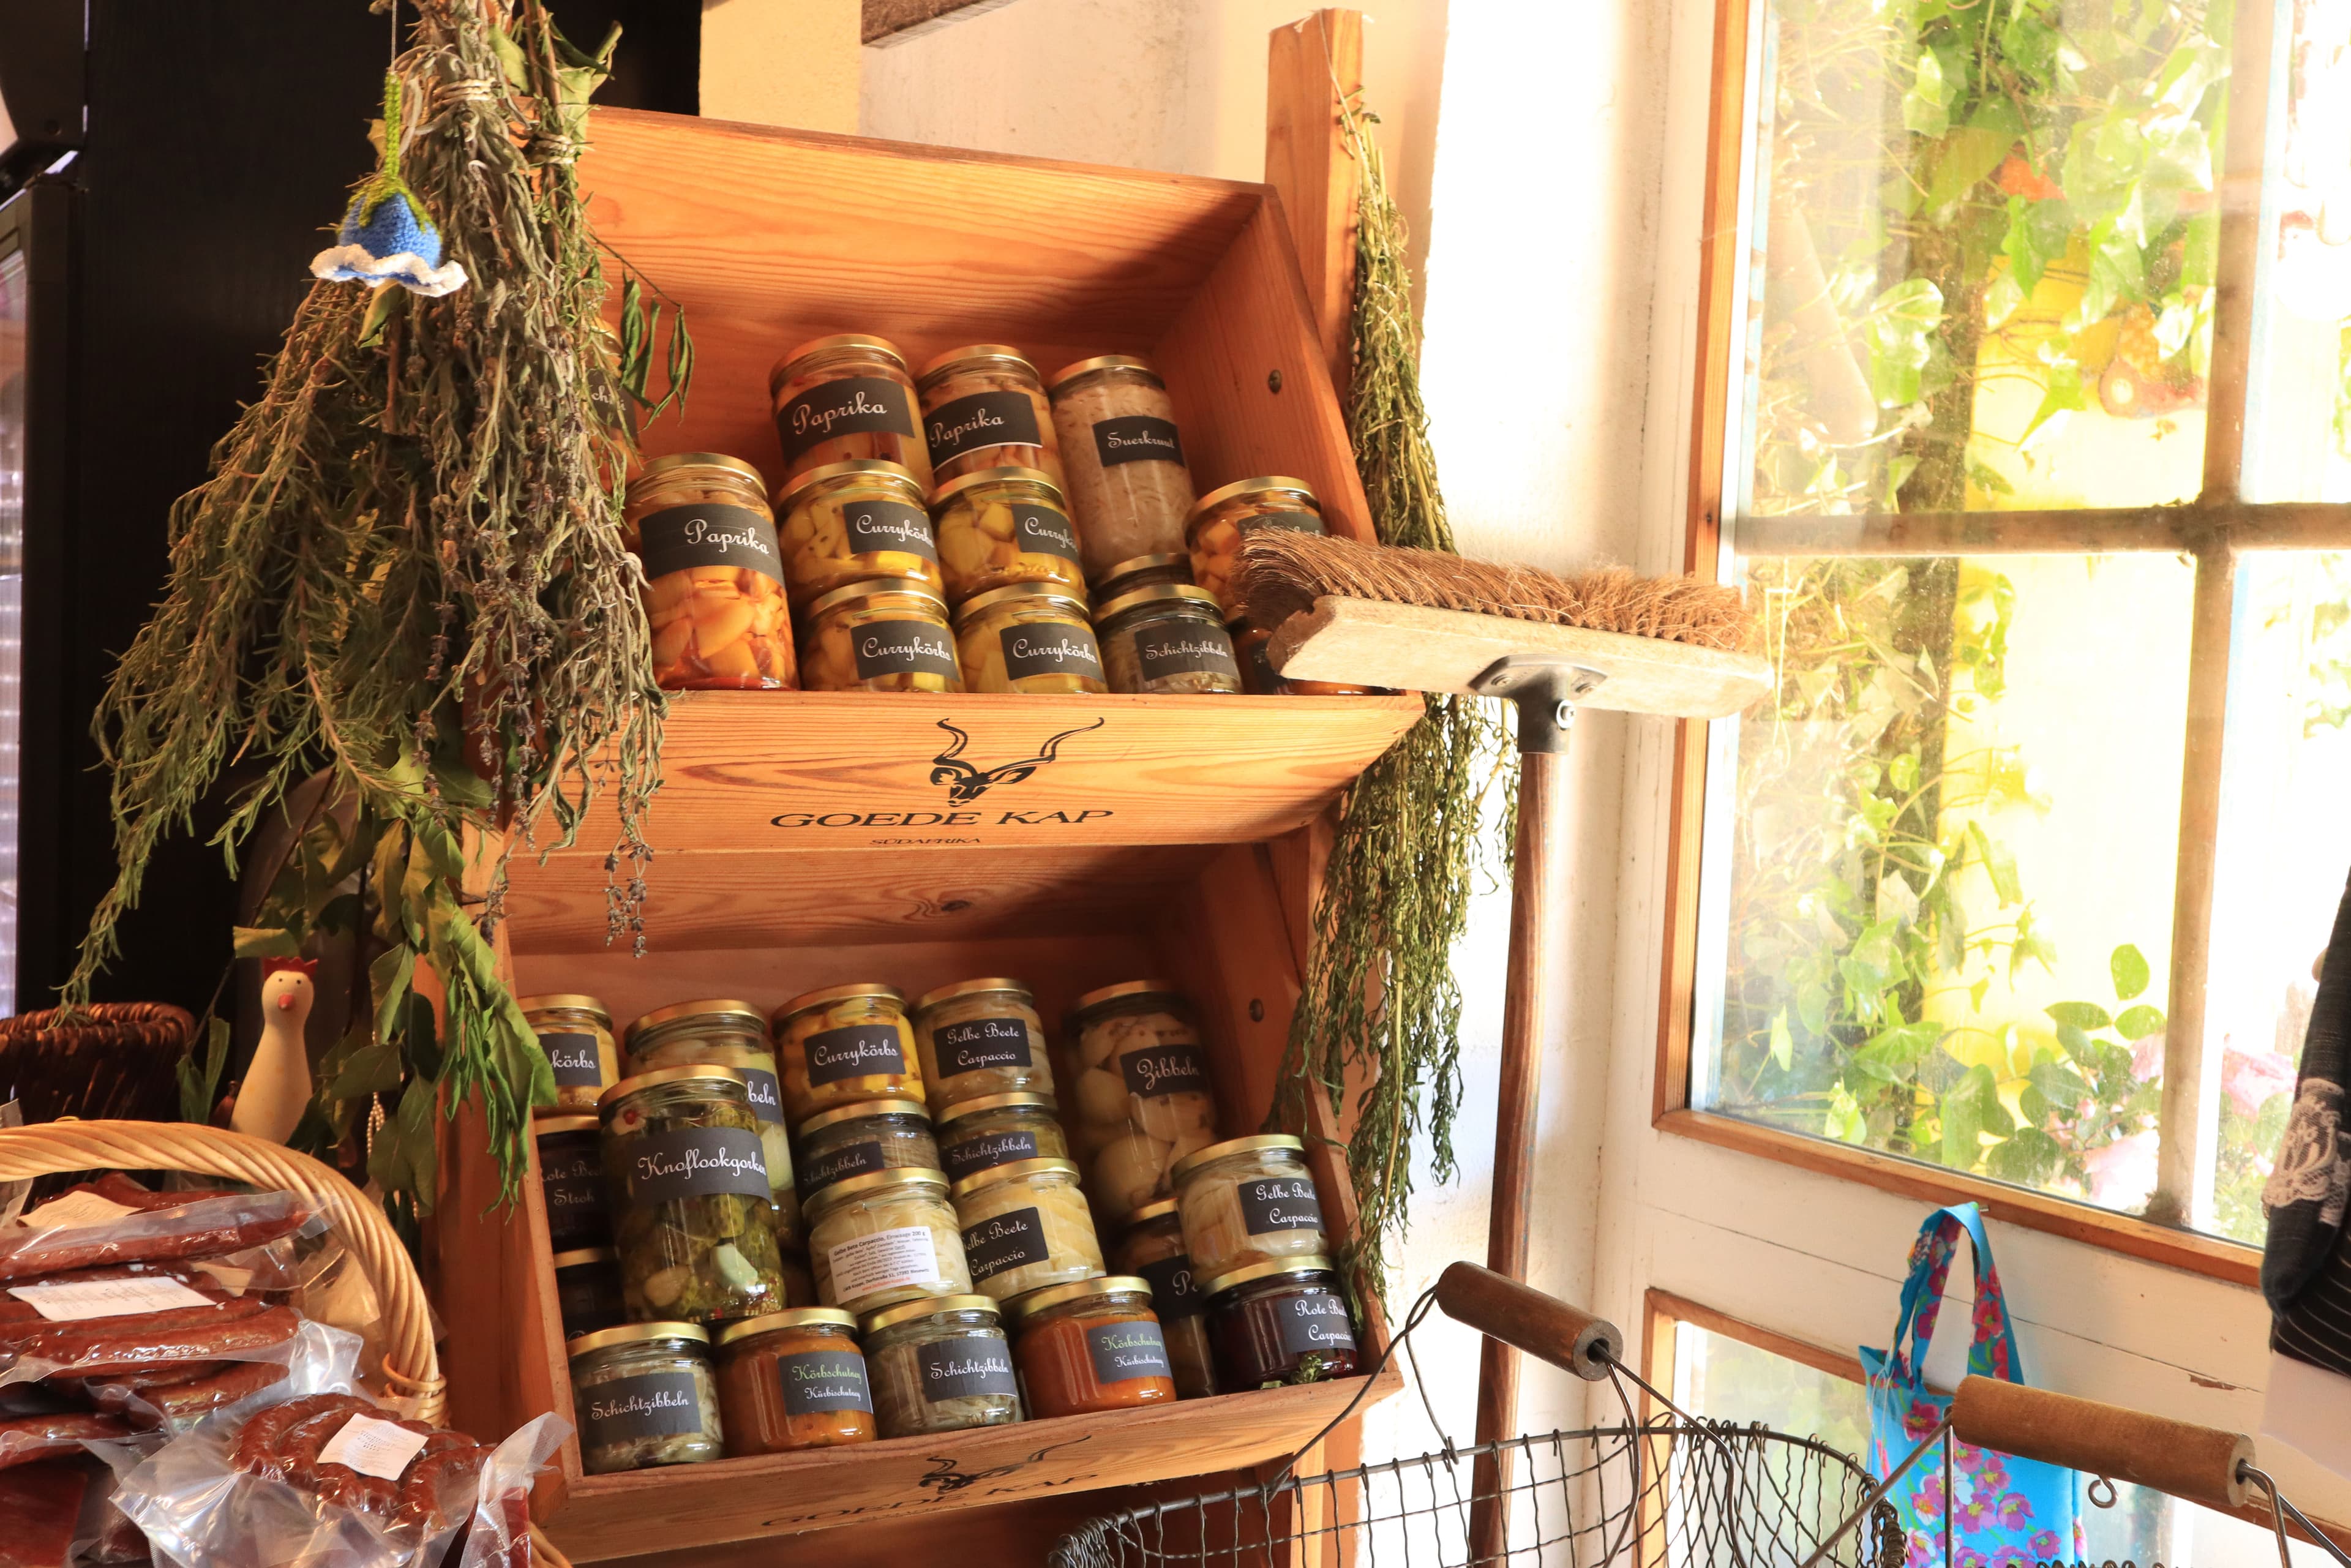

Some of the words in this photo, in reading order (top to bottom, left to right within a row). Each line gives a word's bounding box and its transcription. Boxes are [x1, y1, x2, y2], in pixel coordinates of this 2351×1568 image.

[792, 391, 888, 434] Paprika
[929, 408, 1004, 447] Paprika
[684, 518, 770, 555] Paprika
[770, 812, 982, 828] GOEDE
[996, 810, 1114, 825] KAP
[871, 837, 981, 846] SÜDAFRIKA
[947, 1027, 980, 1045] Gelbe
[984, 1022, 1019, 1038] Beete
[814, 1038, 898, 1066] Currykörbs
[957, 1049, 1016, 1068] Carpaccio
[1137, 1057, 1199, 1090] Zibbeln
[952, 1136, 1032, 1164] Schichtzibbeln
[542, 1168, 566, 1182] ote
[1255, 1184, 1290, 1201] Gelbe
[989, 1220, 1029, 1240] Beete
[970, 1247, 1026, 1277] Carpaccio
[1295, 1299, 1327, 1317] Rote
[930, 1357, 1009, 1379] Schichtzibbeln
[591, 1390, 690, 1421] Schichtzibbeln
